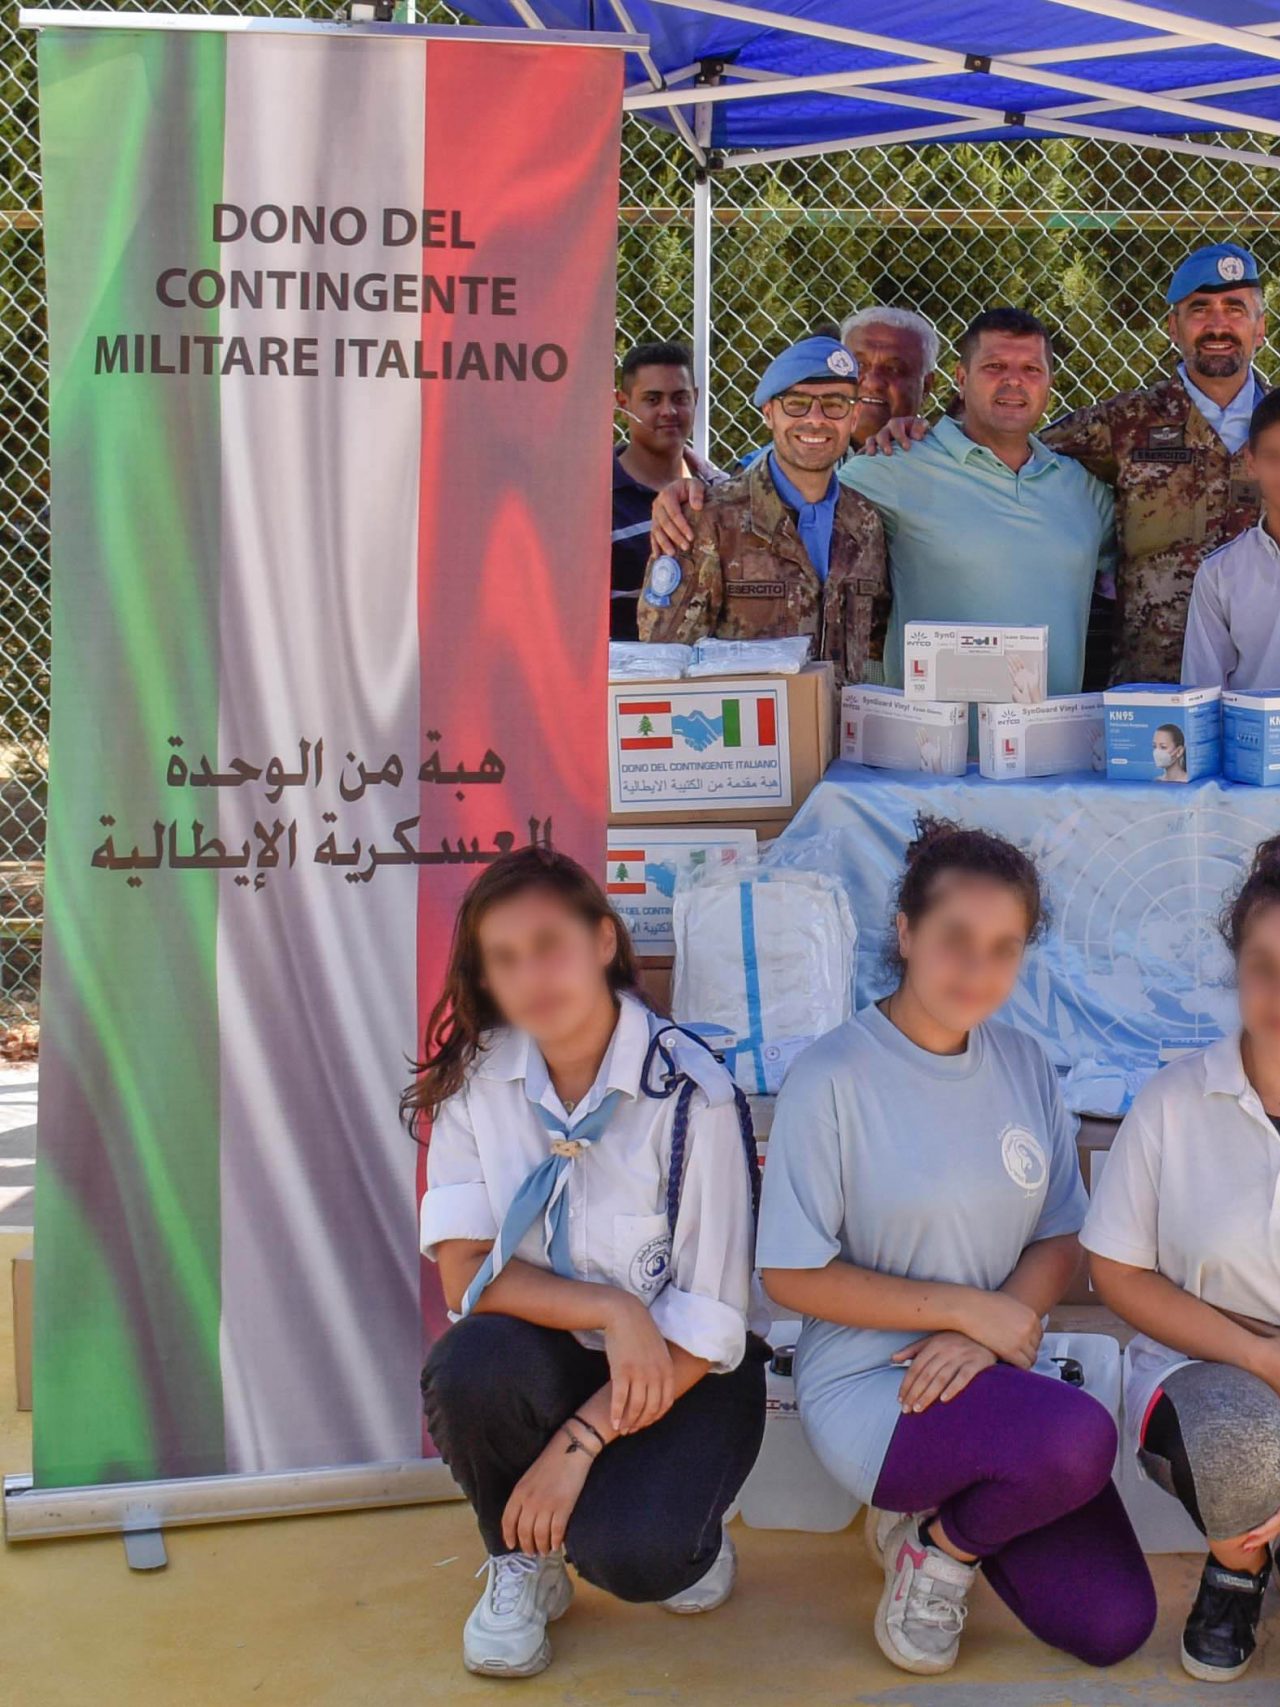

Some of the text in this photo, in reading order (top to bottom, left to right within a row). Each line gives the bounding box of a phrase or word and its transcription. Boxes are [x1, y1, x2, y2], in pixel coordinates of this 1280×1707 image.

[212, 203, 476, 249] DONO DEL
[155, 267, 517, 316] CONTINGENTE
[94, 334, 568, 382] MILITARE ITALIANO
[727, 584, 782, 594] ESERCITO
[934, 631, 956, 639] SynG
[914, 660, 924, 673] L
[1059, 704, 1078, 713] Vinyl
[1109, 711, 1134, 721] KN95
[846, 721, 855, 737] L
[1005, 739, 1015, 752] L
[166, 729, 506, 804] هبة من الوحدة
[621, 759, 778, 773] DONO DEL CONTINGENTE ITALIANO
[707, 780, 723, 793] من
[90, 811, 552, 892] العسكرية الإيطالية
[642, 906, 674, 915] CONTIN
